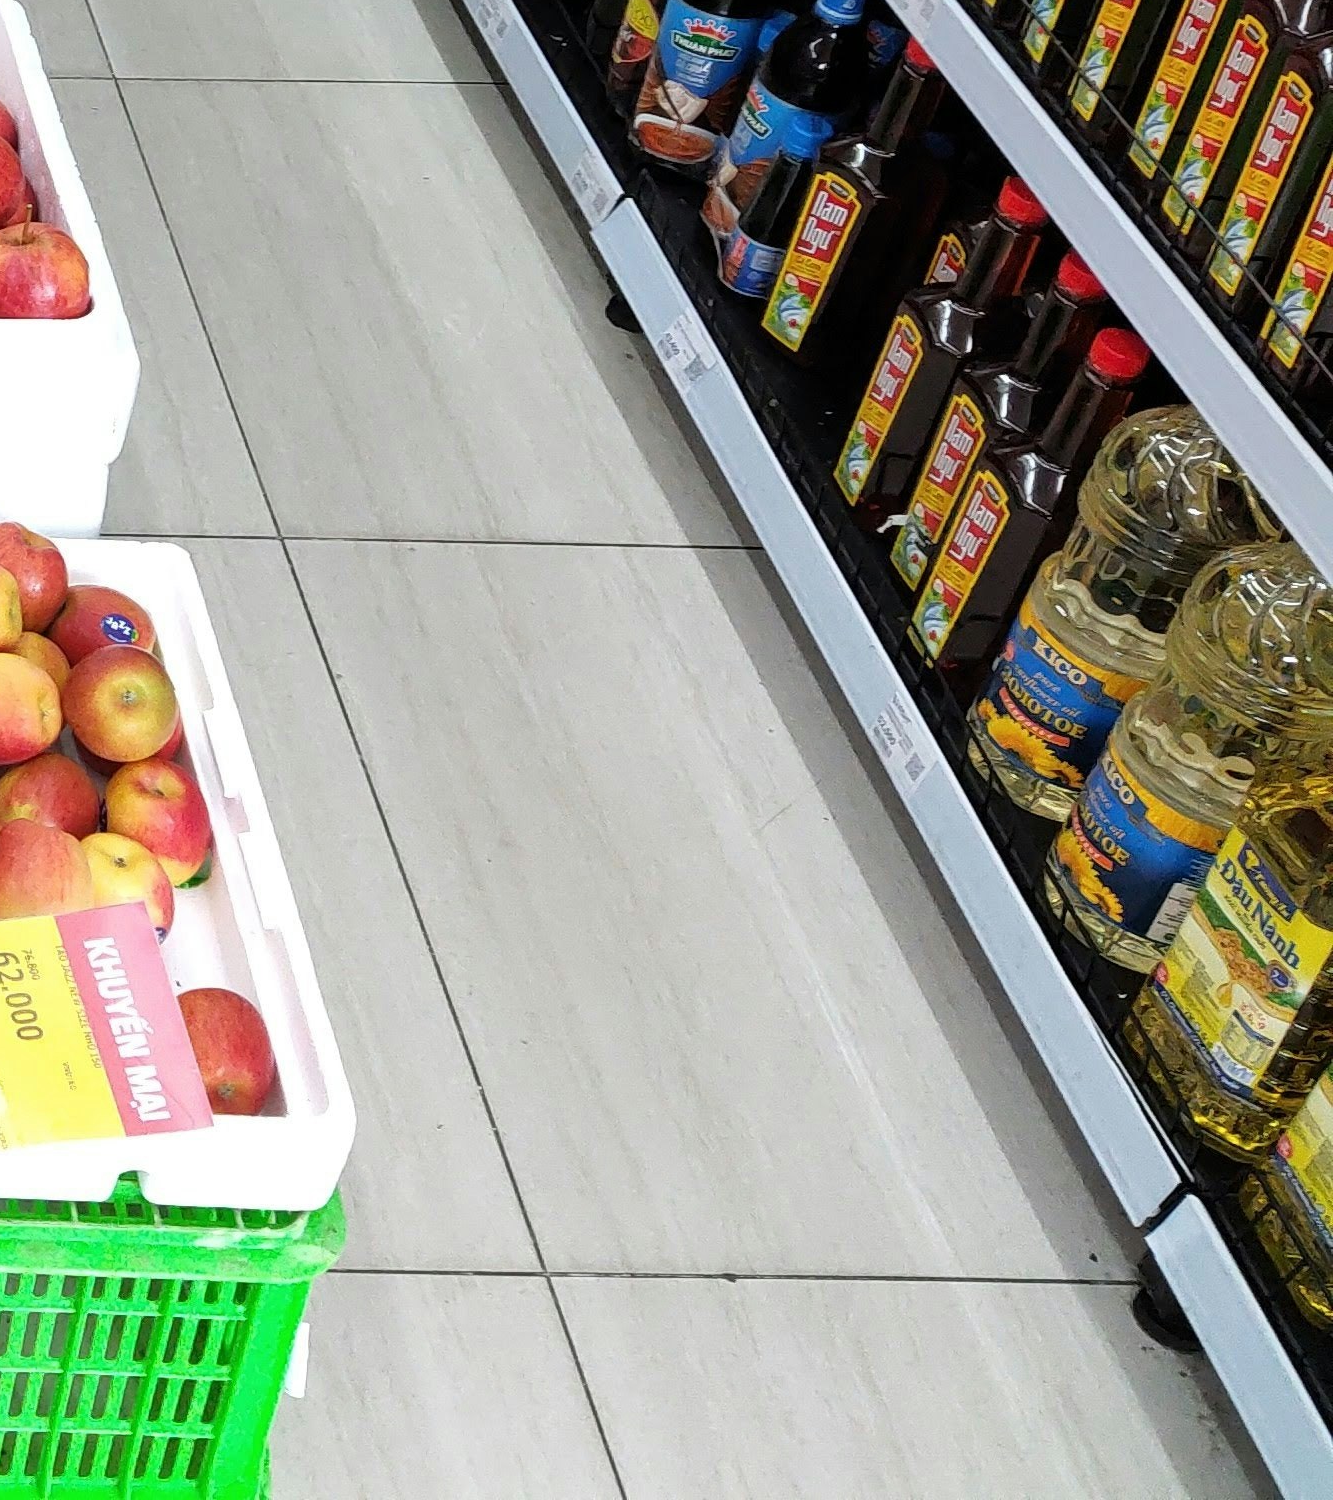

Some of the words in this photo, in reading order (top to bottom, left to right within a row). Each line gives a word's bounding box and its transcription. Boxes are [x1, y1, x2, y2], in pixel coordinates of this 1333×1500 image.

[1032, 635, 1089, 687] KICO
[82, 937, 155, 1059] KHUYẾN
[123, 1064, 171, 1123] MẠI
